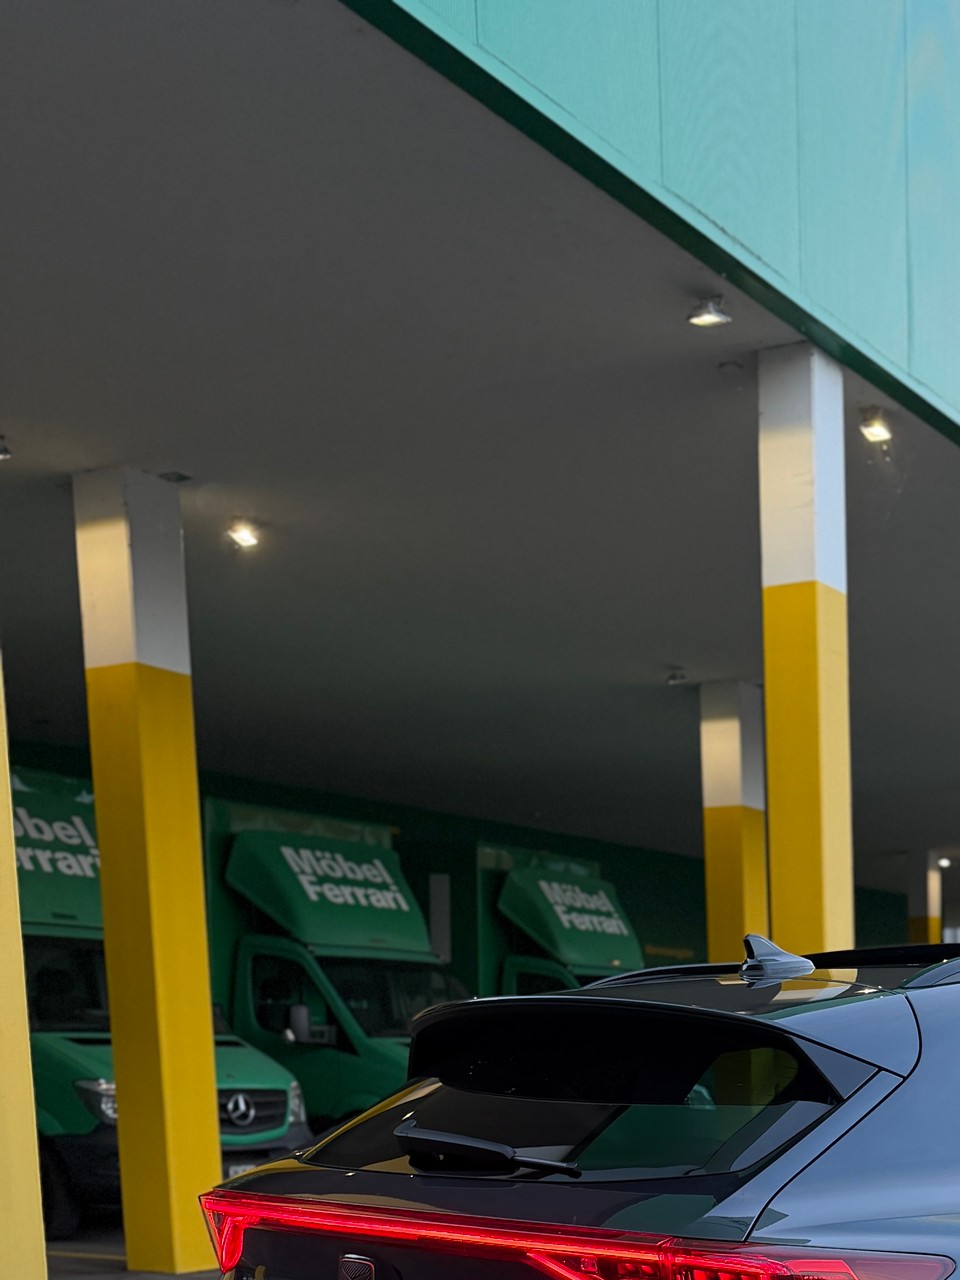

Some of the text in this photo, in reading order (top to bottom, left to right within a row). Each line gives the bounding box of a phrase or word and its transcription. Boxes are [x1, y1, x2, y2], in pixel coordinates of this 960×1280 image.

[14, 806, 96, 847] bel
[280, 845, 394, 885] Möbel
[297, 873, 410, 912] Ferrari
